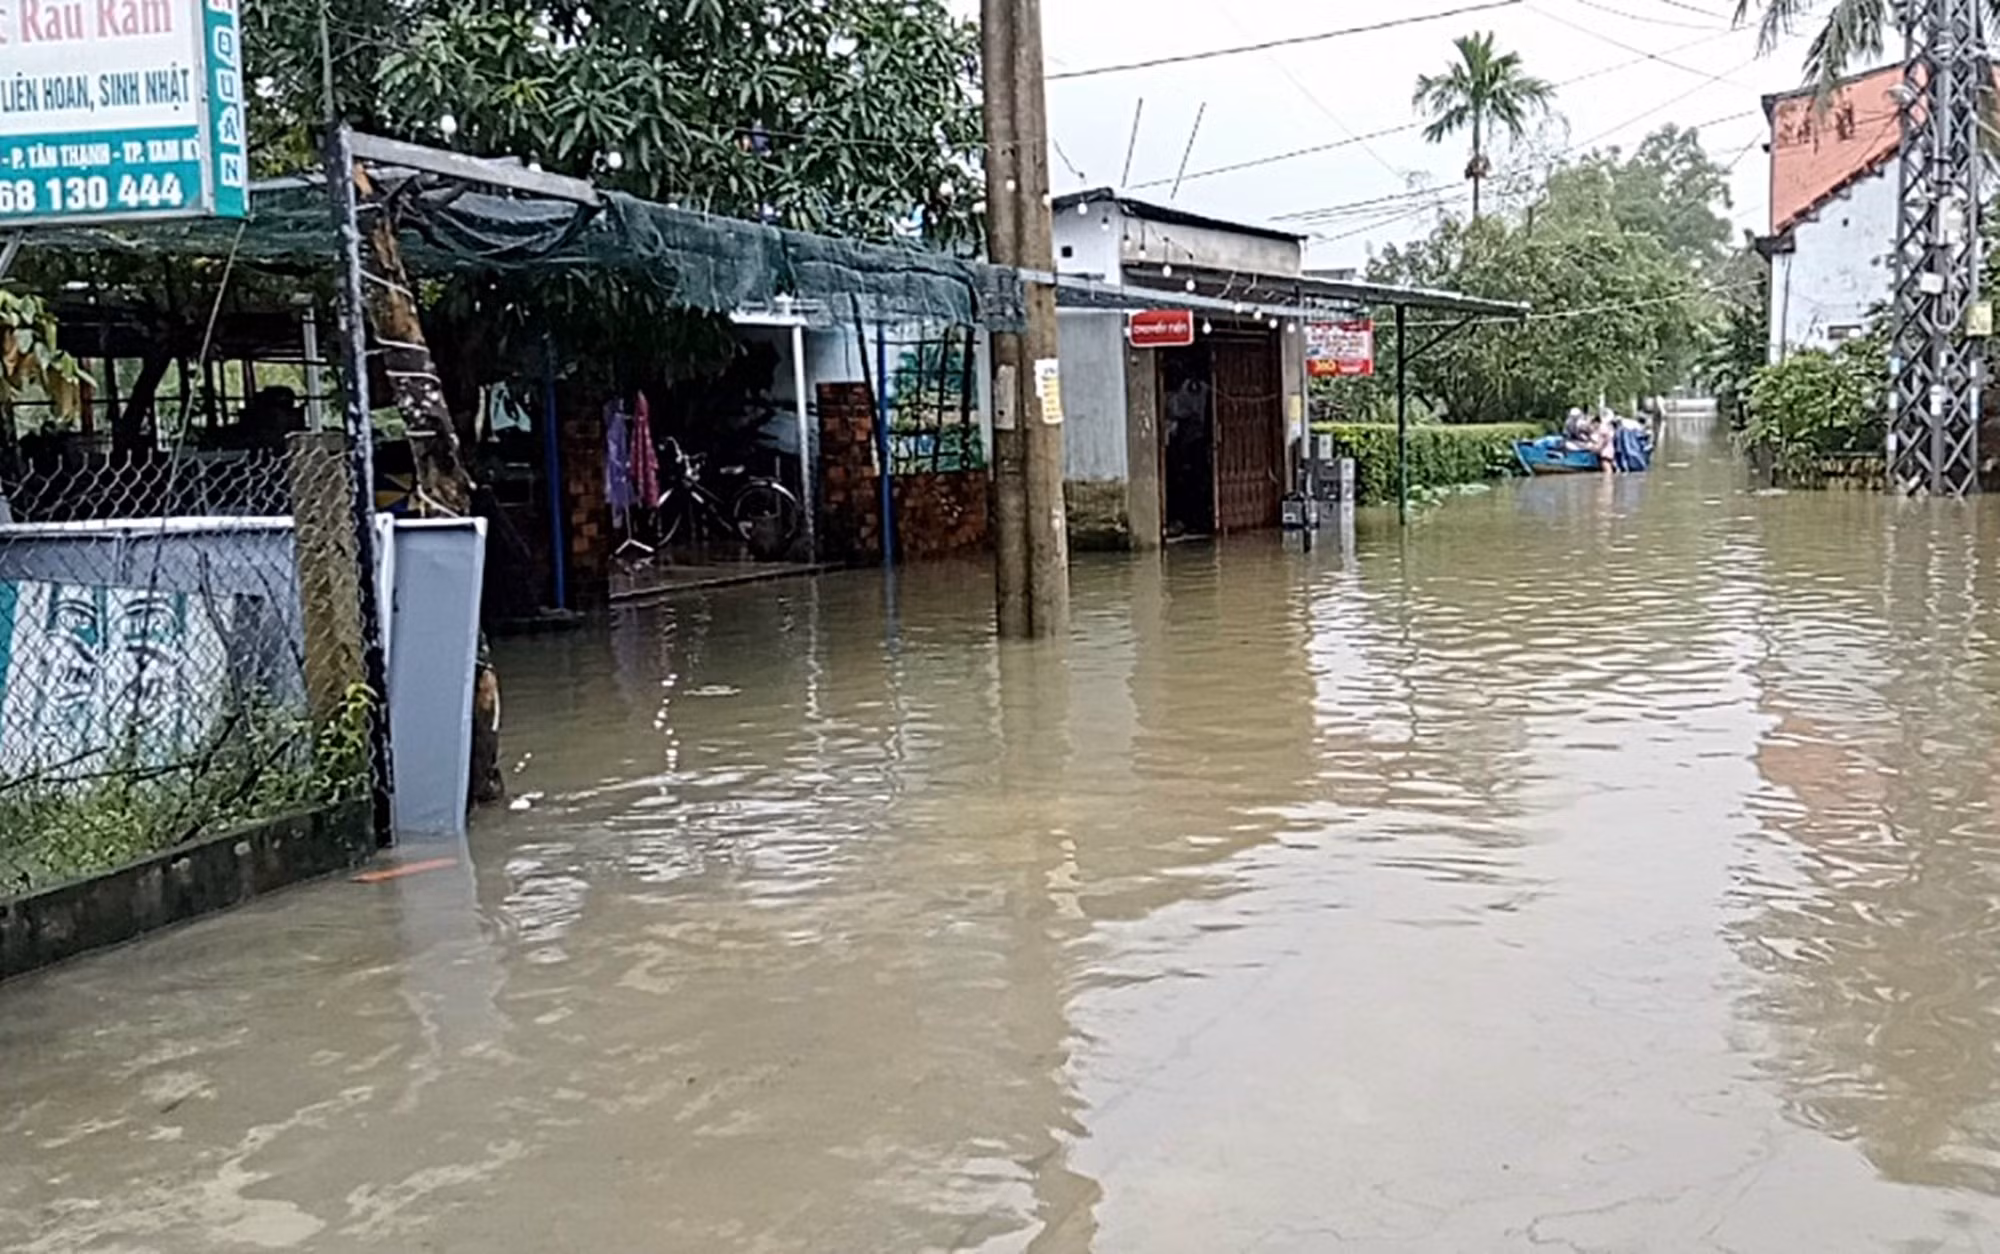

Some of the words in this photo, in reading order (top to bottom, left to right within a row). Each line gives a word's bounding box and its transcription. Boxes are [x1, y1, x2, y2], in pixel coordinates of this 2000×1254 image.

[99, 71, 140, 107] SINH
[145, 61, 190, 111] NHẬT
[45, 175, 108, 211] 130
[118, 171, 183, 207] 444
